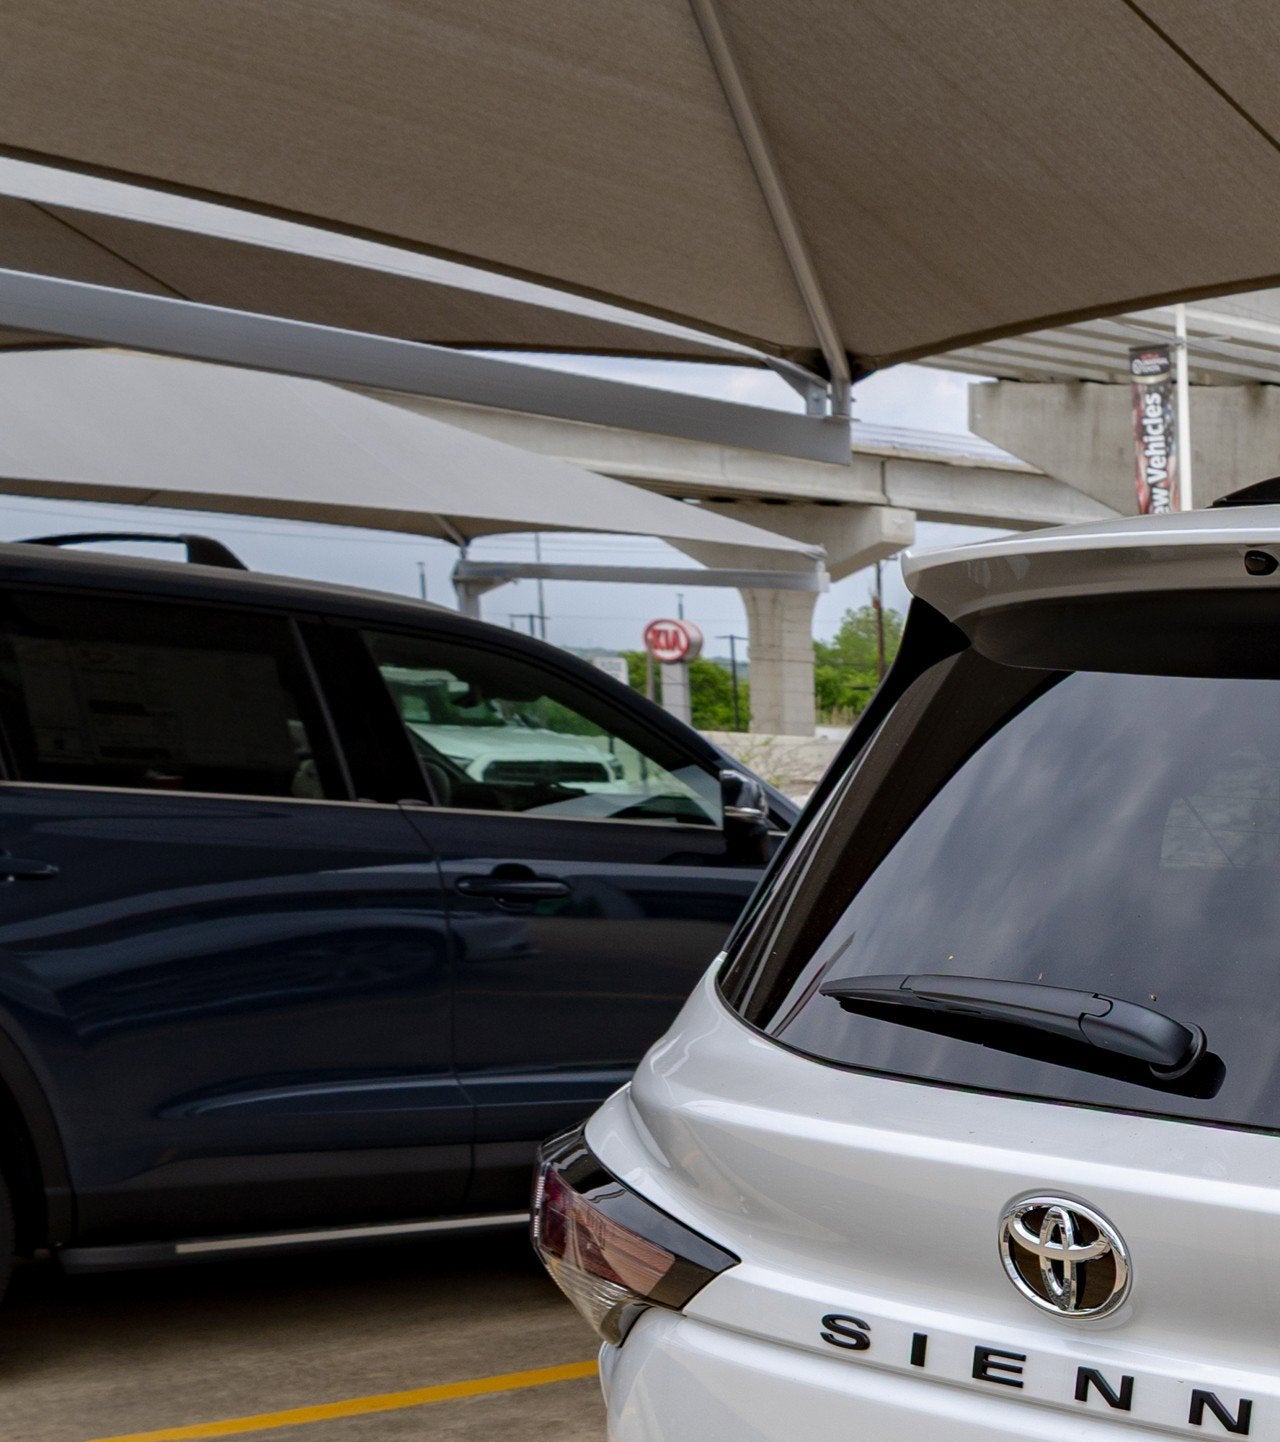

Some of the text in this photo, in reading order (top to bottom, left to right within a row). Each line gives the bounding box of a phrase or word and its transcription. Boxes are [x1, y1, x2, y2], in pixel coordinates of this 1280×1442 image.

[1142, 393, 1168, 485] Vehicles
[1152, 486, 1169, 514] ew
[652, 629, 681, 650] KIA
